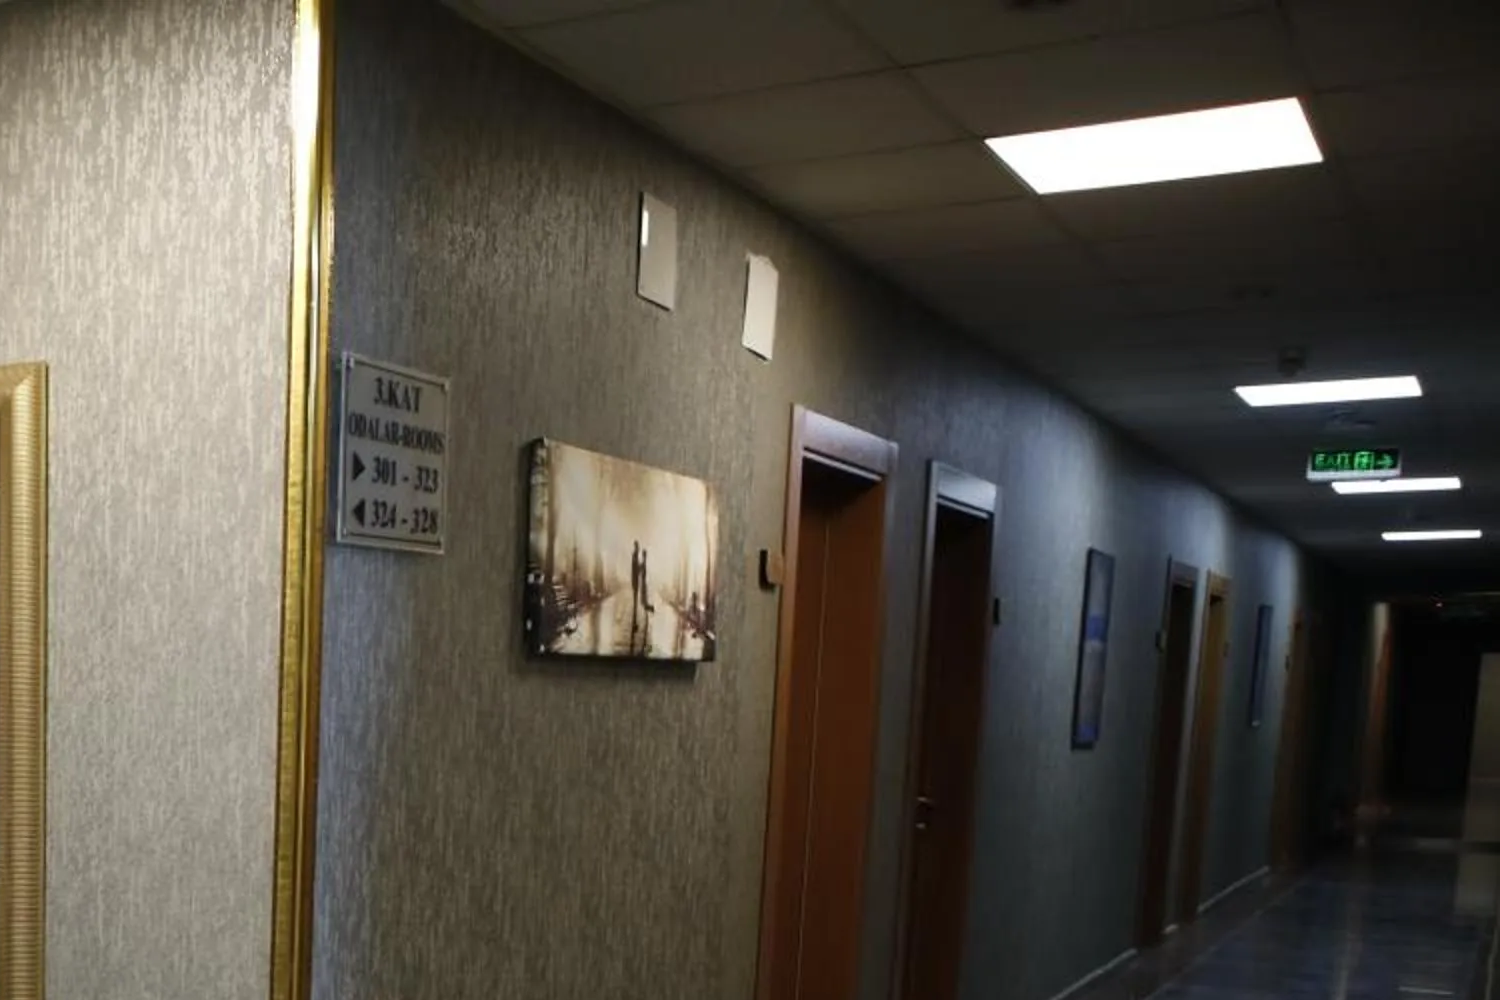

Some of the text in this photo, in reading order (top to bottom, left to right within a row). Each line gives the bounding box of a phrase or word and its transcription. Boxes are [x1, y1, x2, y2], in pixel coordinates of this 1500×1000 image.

[373, 376, 422, 414] 3.KAT
[371, 456, 397, 487] 301
[414, 465, 439, 494] 323
[371, 499, 397, 529] 324
[410, 507, 439, 535] 328
